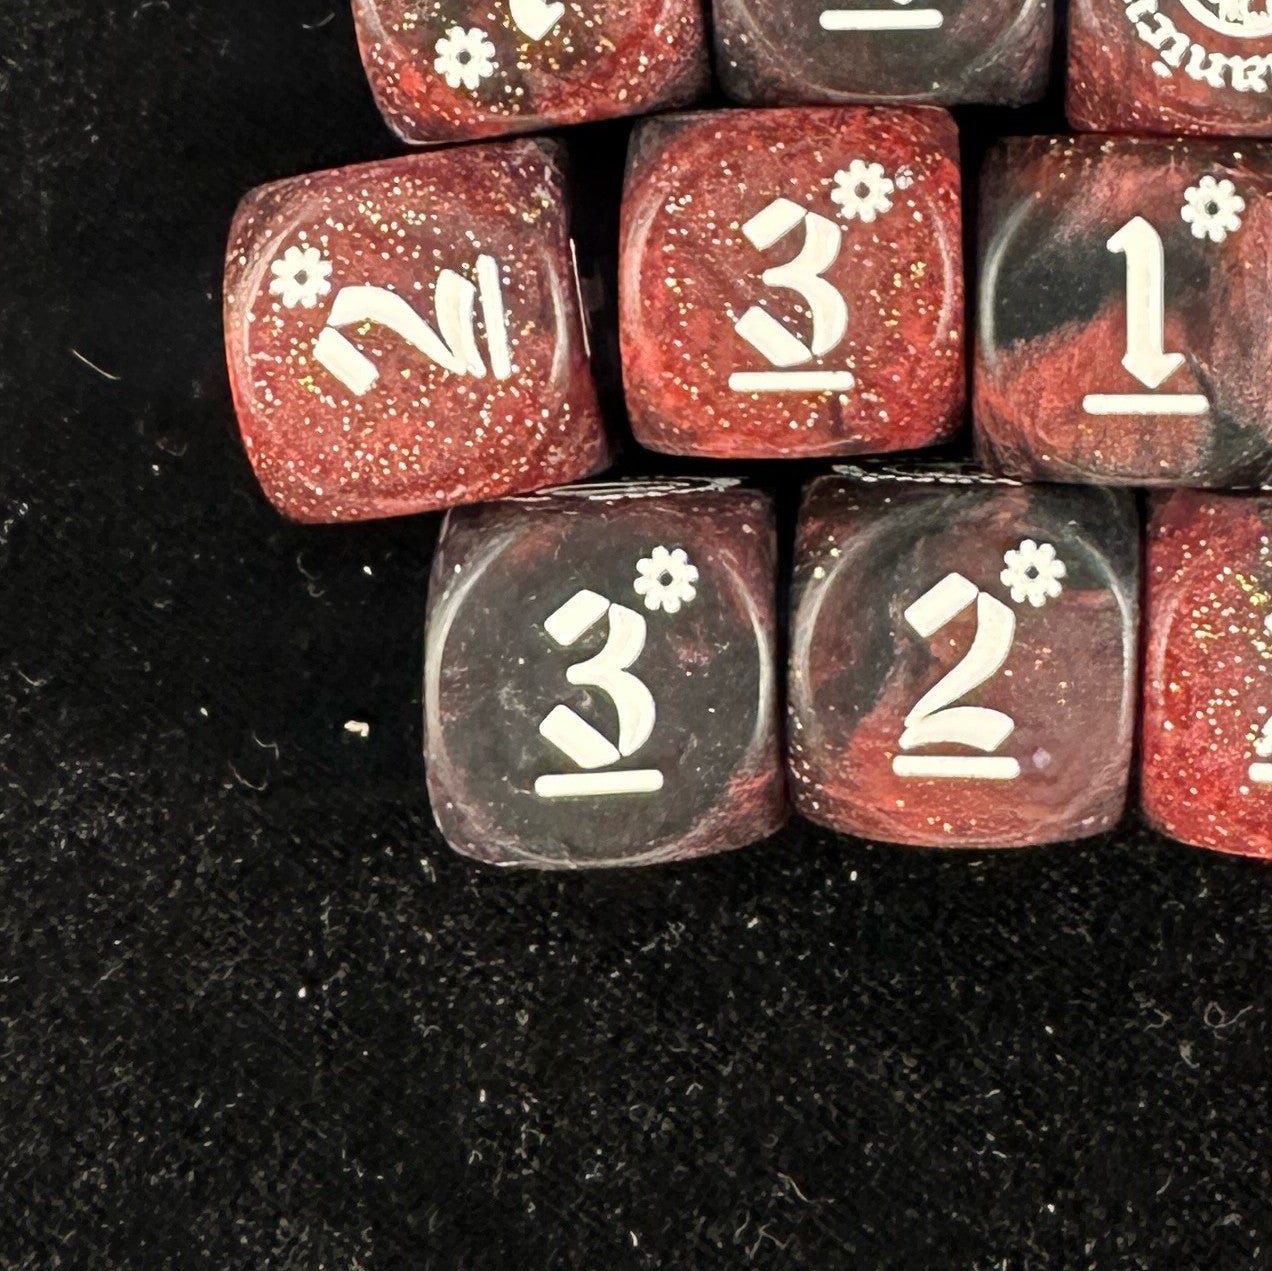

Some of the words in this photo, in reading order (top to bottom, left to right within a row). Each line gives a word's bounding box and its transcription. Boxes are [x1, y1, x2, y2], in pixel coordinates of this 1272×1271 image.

[313, 267, 486, 396] 2
[733, 196, 850, 367] 3
[1105, 215, 1187, 390] 1
[537, 588, 657, 770] 3
[897, 571, 1017, 753] 2
